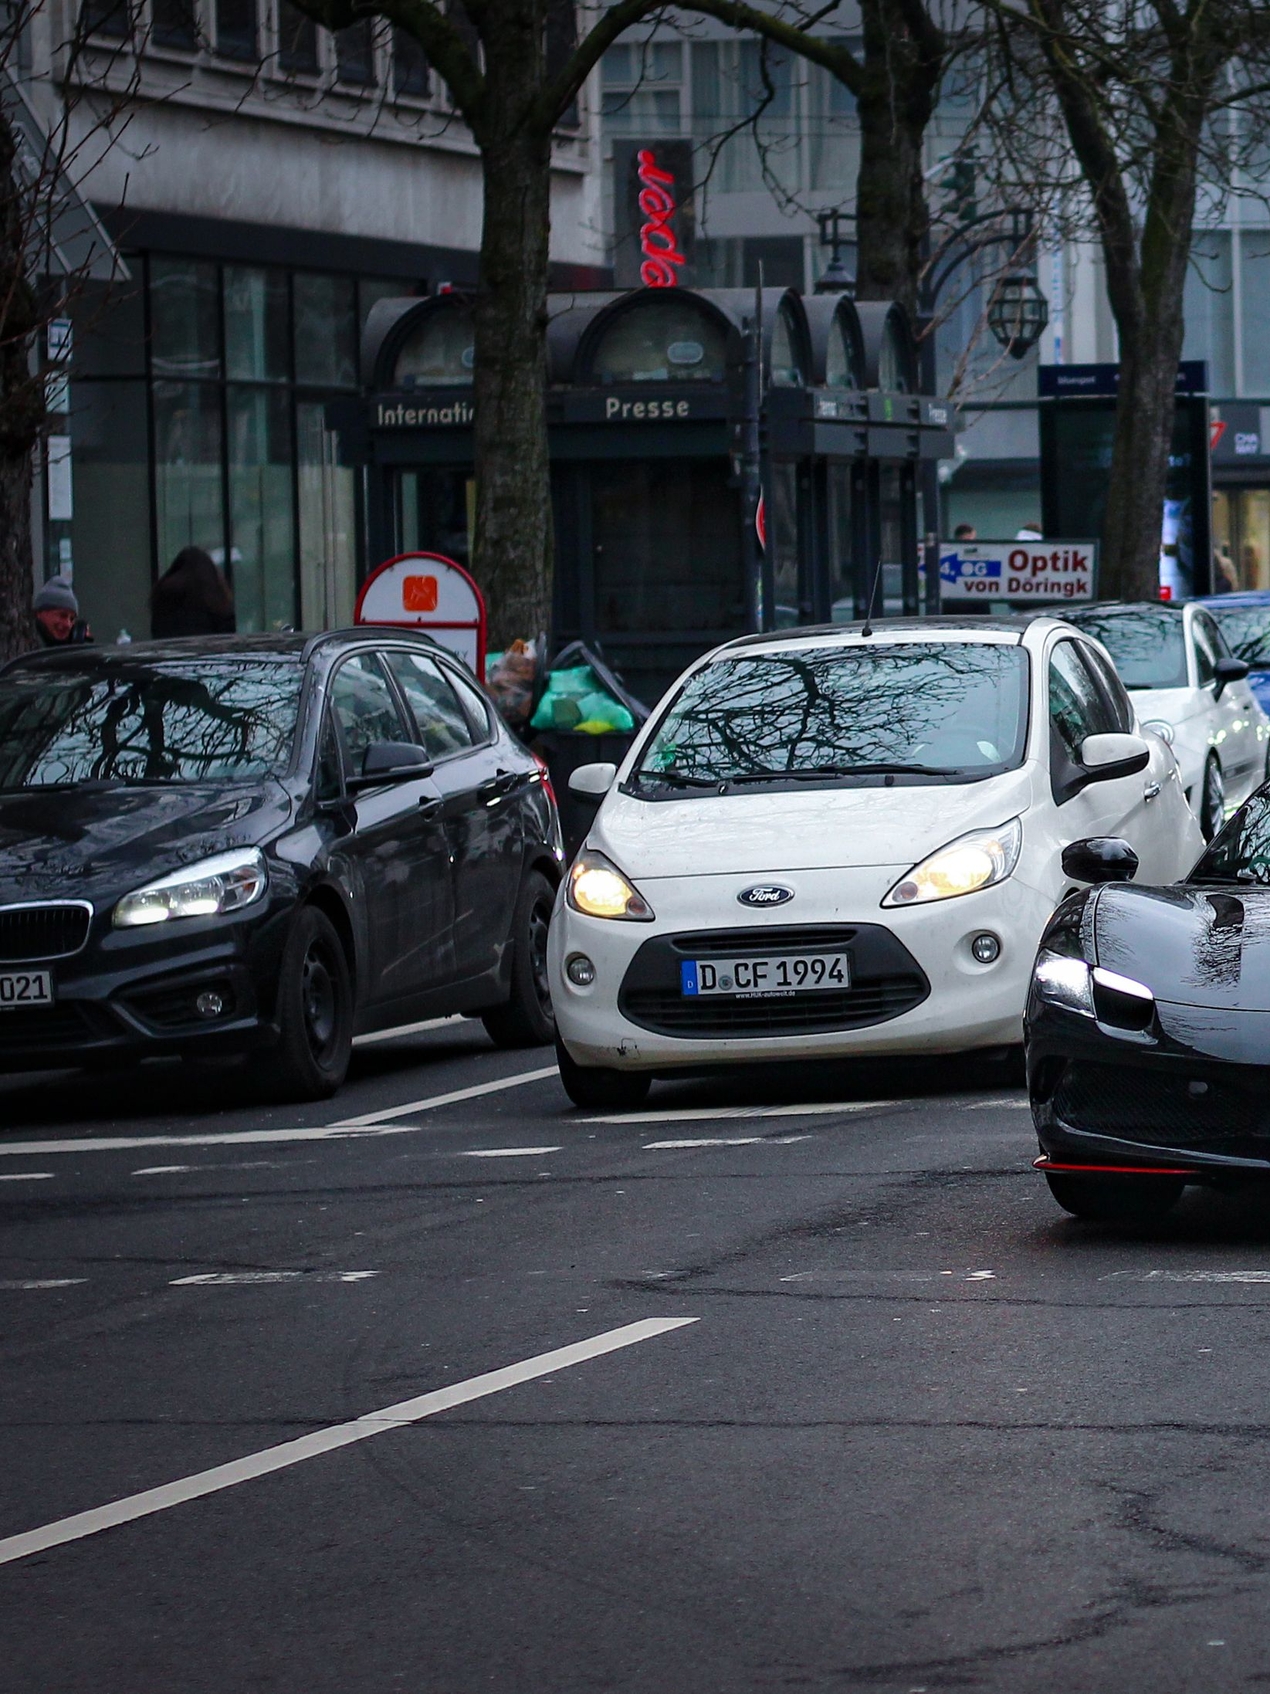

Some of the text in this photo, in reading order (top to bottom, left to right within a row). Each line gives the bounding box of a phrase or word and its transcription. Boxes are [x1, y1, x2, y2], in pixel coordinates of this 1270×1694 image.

[606, 397, 690, 419] Presse
[960, 562, 988, 577] OG
[1008, 549, 1088, 577] Optik
[964, 577, 1088, 598] von Döringk
[749, 887, 780, 902] Ford
[700, 957, 844, 990] D CF 1994
